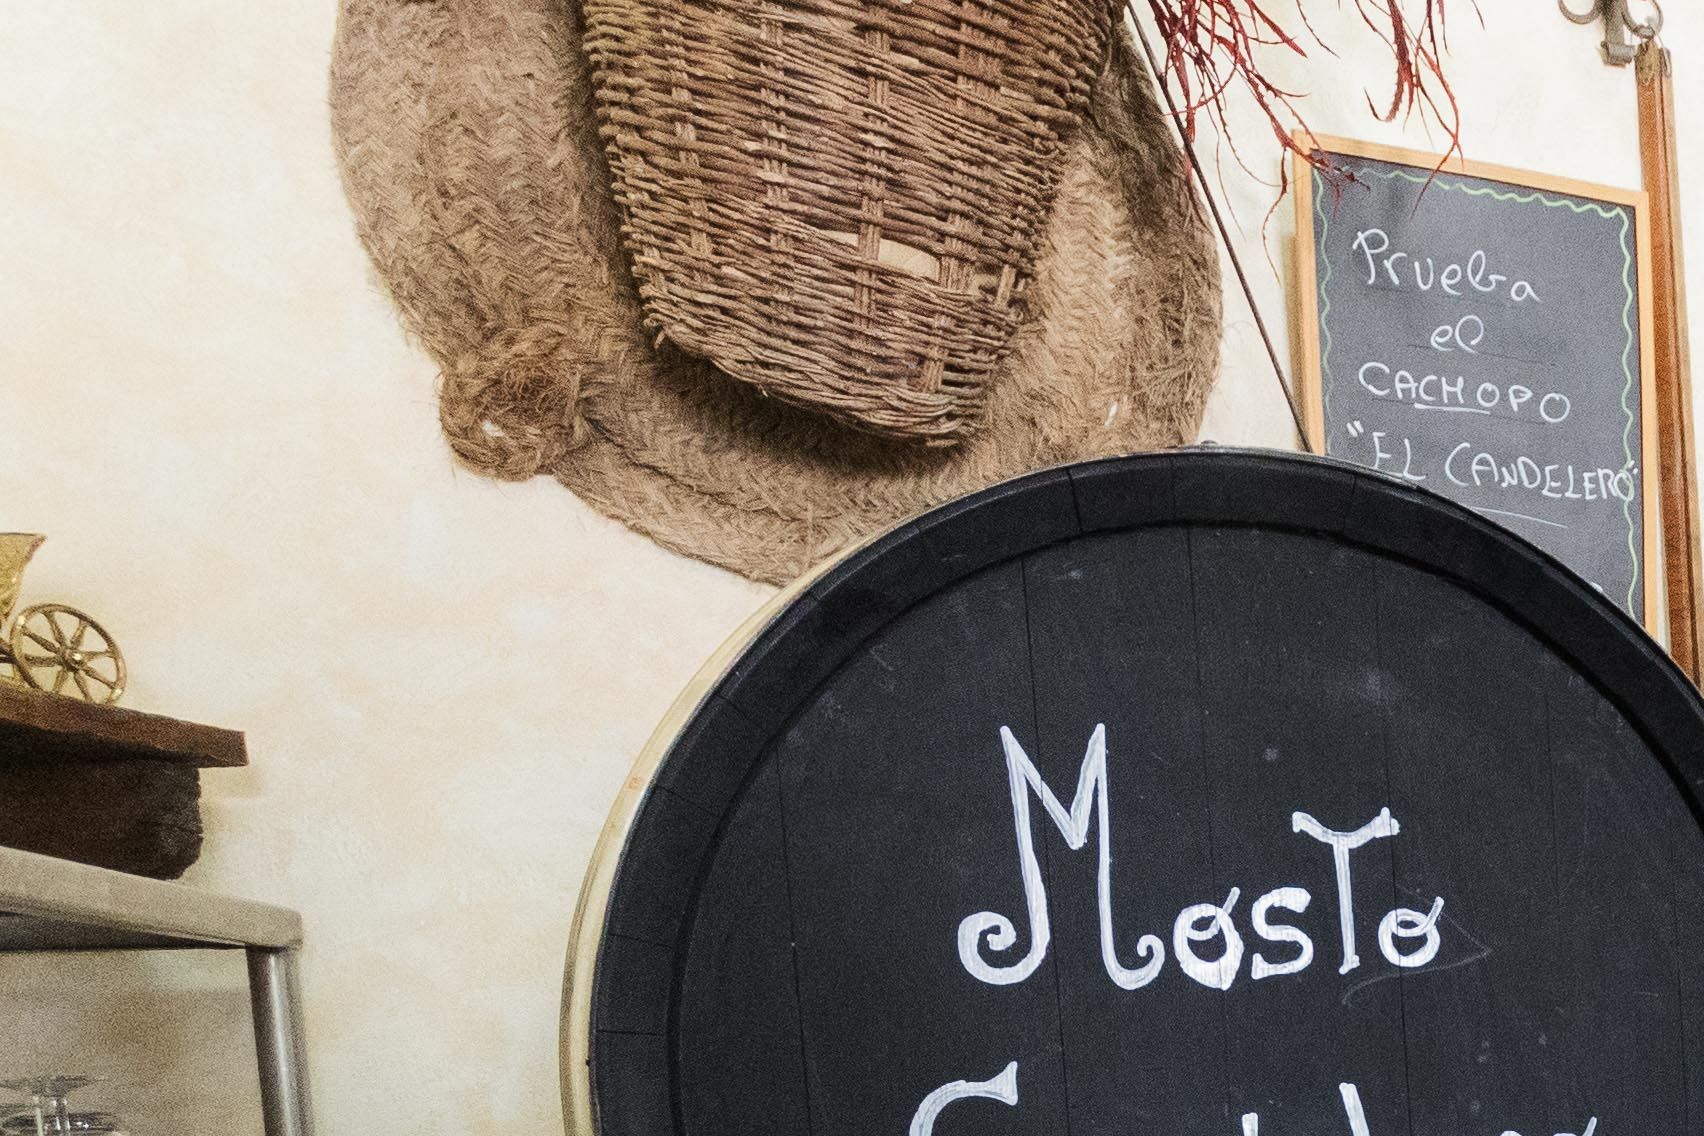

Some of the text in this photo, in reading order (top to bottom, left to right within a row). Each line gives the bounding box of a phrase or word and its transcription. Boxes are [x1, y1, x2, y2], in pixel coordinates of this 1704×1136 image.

[1352, 227, 1542, 302] Prueba
[1430, 314, 1484, 354] el
[1358, 362, 1572, 424] CACHOPO
